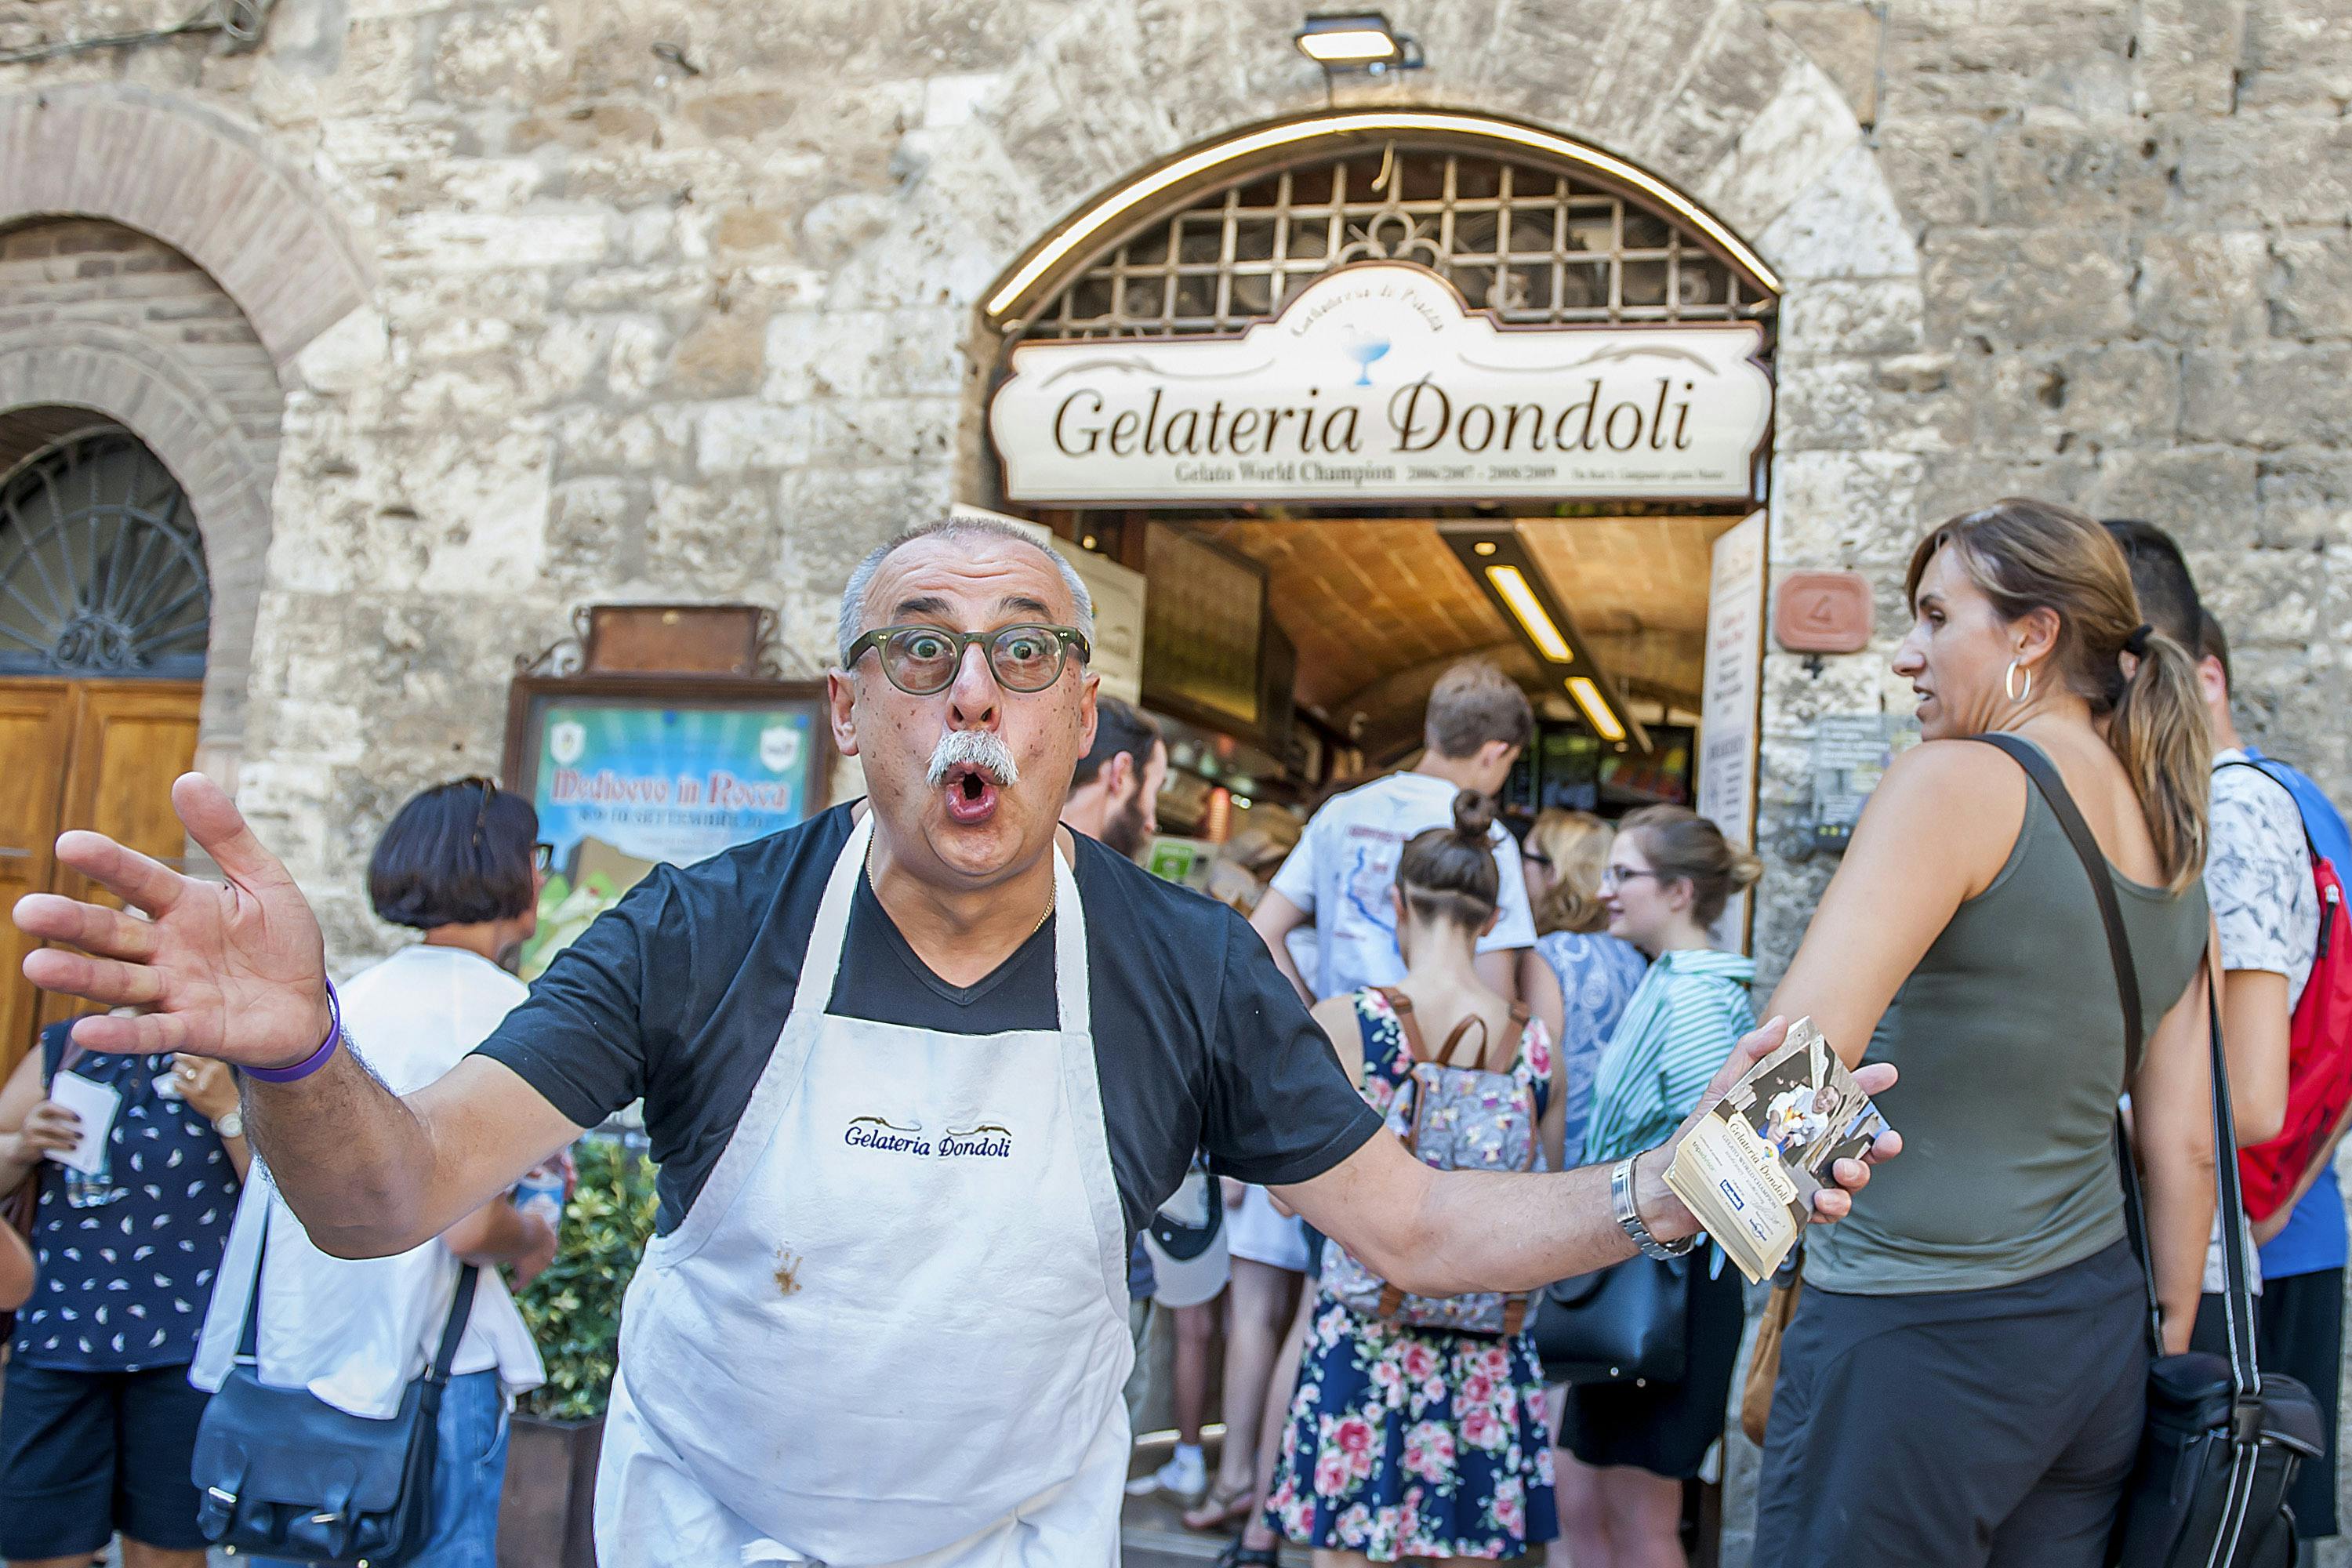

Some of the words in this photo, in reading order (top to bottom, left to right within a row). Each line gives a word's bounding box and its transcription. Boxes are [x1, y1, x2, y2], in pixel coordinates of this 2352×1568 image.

[1054, 387, 1364, 458] Gelateria
[1388, 372, 1695, 455] Dondoli
[1176, 460, 1234, 482] Gelato
[1239, 460, 1294, 482] World
[1299, 459, 1396, 488] Champion
[552, 768, 669, 805] Medioevo
[677, 771, 700, 805] in
[708, 770, 787, 811] Rocca
[844, 1127, 931, 1156] Gelateria
[938, 1135, 1012, 1158] Dondoli
[1729, 1123, 1761, 1164] Gelateria
[1757, 1162, 1789, 1202] Dondoli
